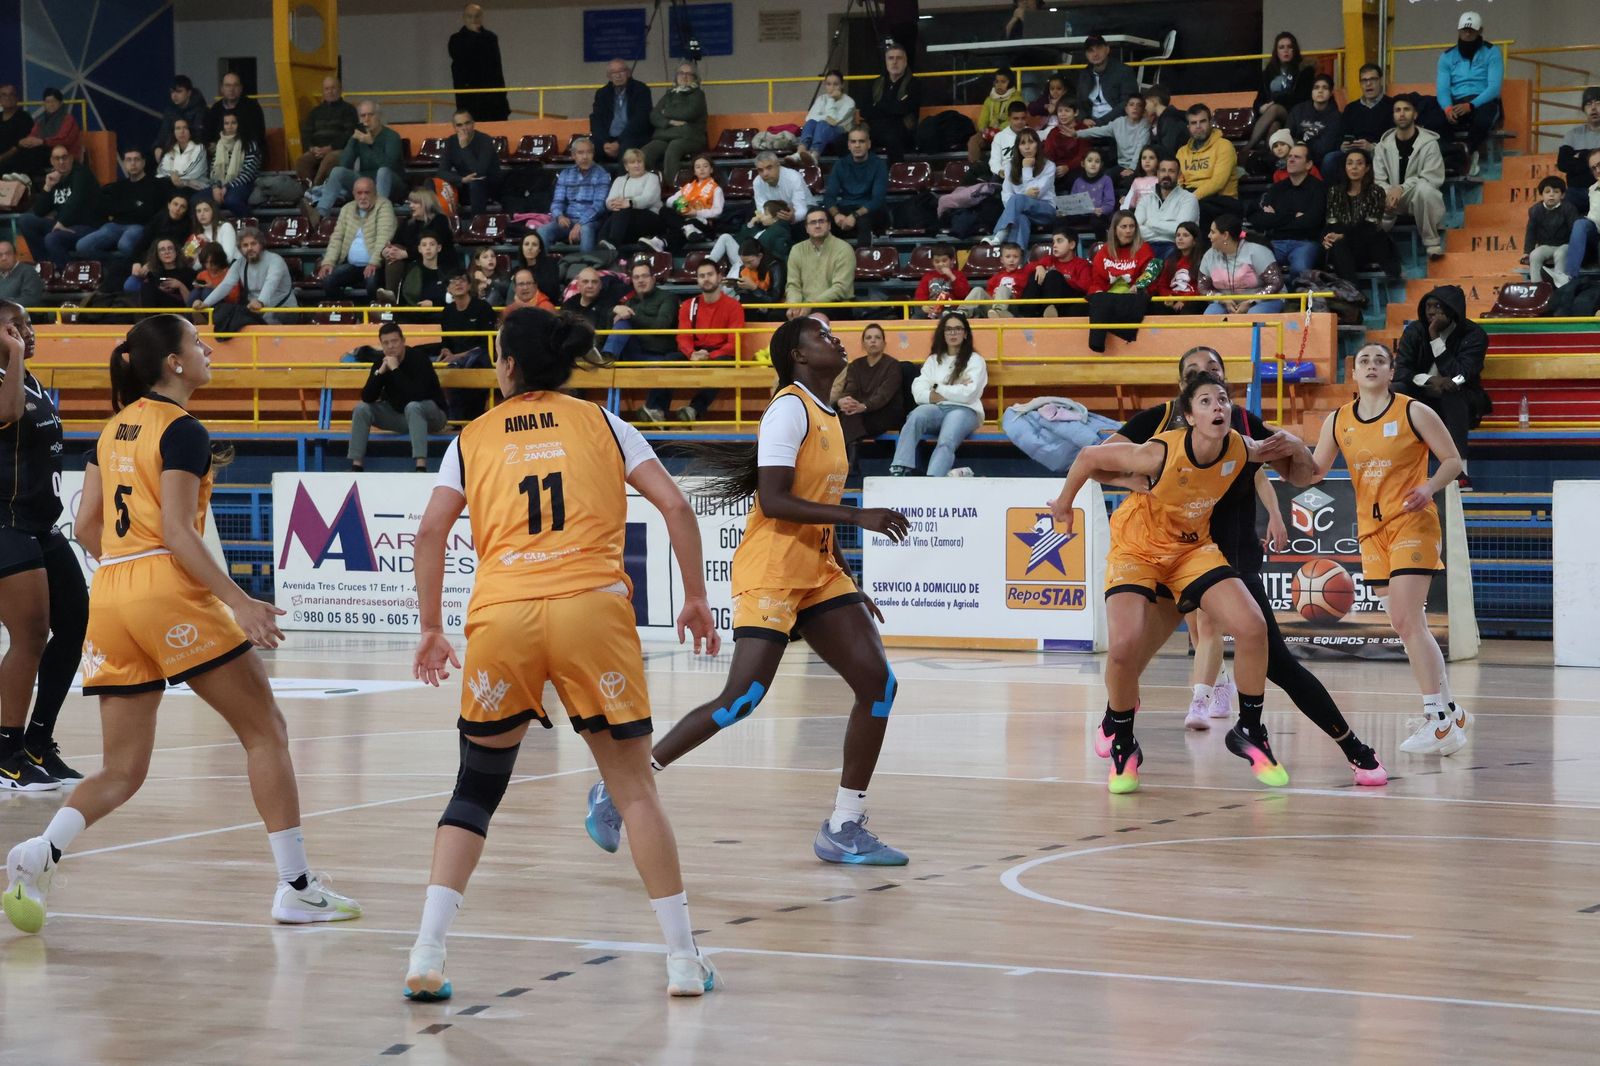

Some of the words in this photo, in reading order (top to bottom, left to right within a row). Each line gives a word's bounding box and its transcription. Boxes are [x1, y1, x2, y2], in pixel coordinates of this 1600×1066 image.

[1229, 112, 1240, 120] 17
[736, 132, 744, 141] 2
[1184, 159, 1209, 171] VANS
[907, 166, 916, 177] 7
[488, 217, 497, 227] 8
[1471, 236, 1517, 251] FILA
[872, 250, 881, 261] 9
[79, 265, 91, 273] 22
[1519, 286, 1538, 299] 27
[505, 413, 538, 433] AINA
[540, 412, 559, 429] M.
[523, 449, 567, 461] ZAMORA
[518, 471, 566, 535] 11
[114, 484, 133, 538] 5
[926, 507, 936, 517] DE
[939, 507, 949, 517] LA
[952, 507, 978, 518] PLATA
[1292, 501, 1335, 532] DC
[1373, 502, 1382, 521] 4
[925, 521, 938, 532] 021
[913, 536, 928, 547] Vino
[931, 536, 964, 548] (Zamora)
[379, 553, 475, 574] NDÉS
[282, 581, 316, 590] Avenida
[318, 581, 336, 591] Tres
[337, 582, 367, 591] Cruces
[369, 583, 378, 592] 17
[380, 583, 398, 592] Entr
[873, 582, 912, 592] SERVICIO
[914, 582, 920, 592] A
[923, 582, 967, 593] DOMICILIO
[969, 583, 980, 593] DE
[1008, 587, 1085, 606] RepoSTAR
[873, 598, 900, 607] Gasóleo
[901, 598, 909, 607] de
[911, 597, 945, 607] Calefacción
[947, 600, 951, 609] y
[303, 611, 324, 623] 980
[327, 611, 342, 624] 05
[345, 612, 359, 624] 85
[362, 613, 376, 625] 90
[387, 613, 409, 625] 605
[412, 614, 419, 625] 7
[447, 614, 462, 627] 05
[1313, 636, 1365, 645] EQUIPOS
